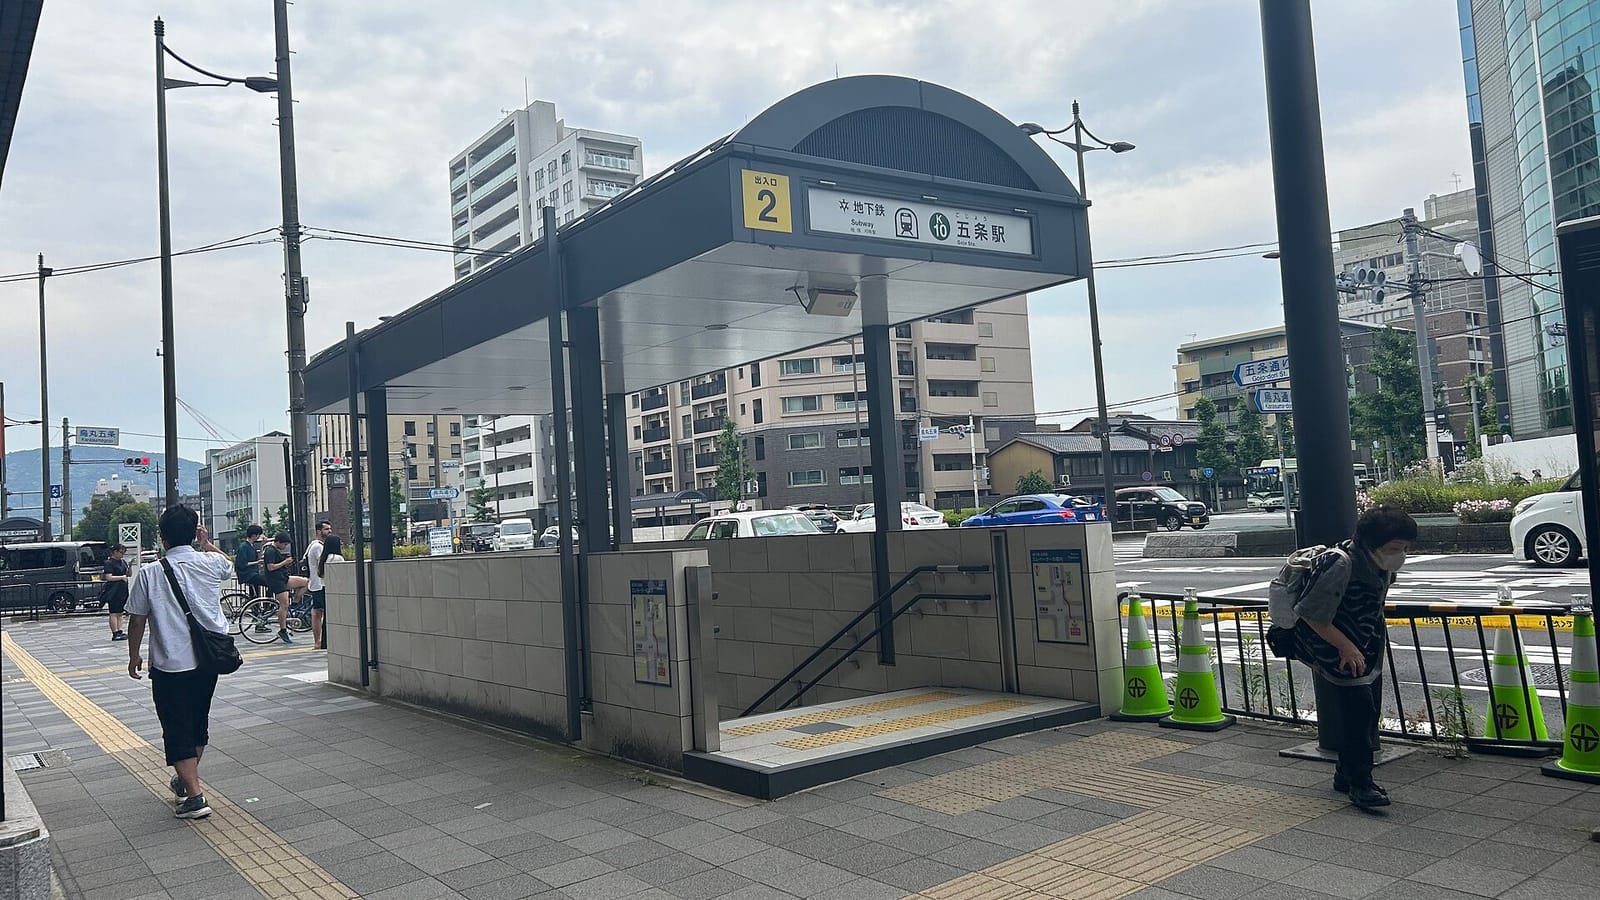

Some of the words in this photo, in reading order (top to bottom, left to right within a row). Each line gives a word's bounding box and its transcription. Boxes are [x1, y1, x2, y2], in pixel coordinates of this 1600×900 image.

[754, 175, 777, 186] 出入口
[757, 189, 778, 223] 2
[853, 200, 885, 217] 地下鉄
[850, 218, 875, 229] Subway
[935, 214, 943, 224] K
[933, 223, 948, 237] 10
[956, 220, 1006, 243] 五条駅
